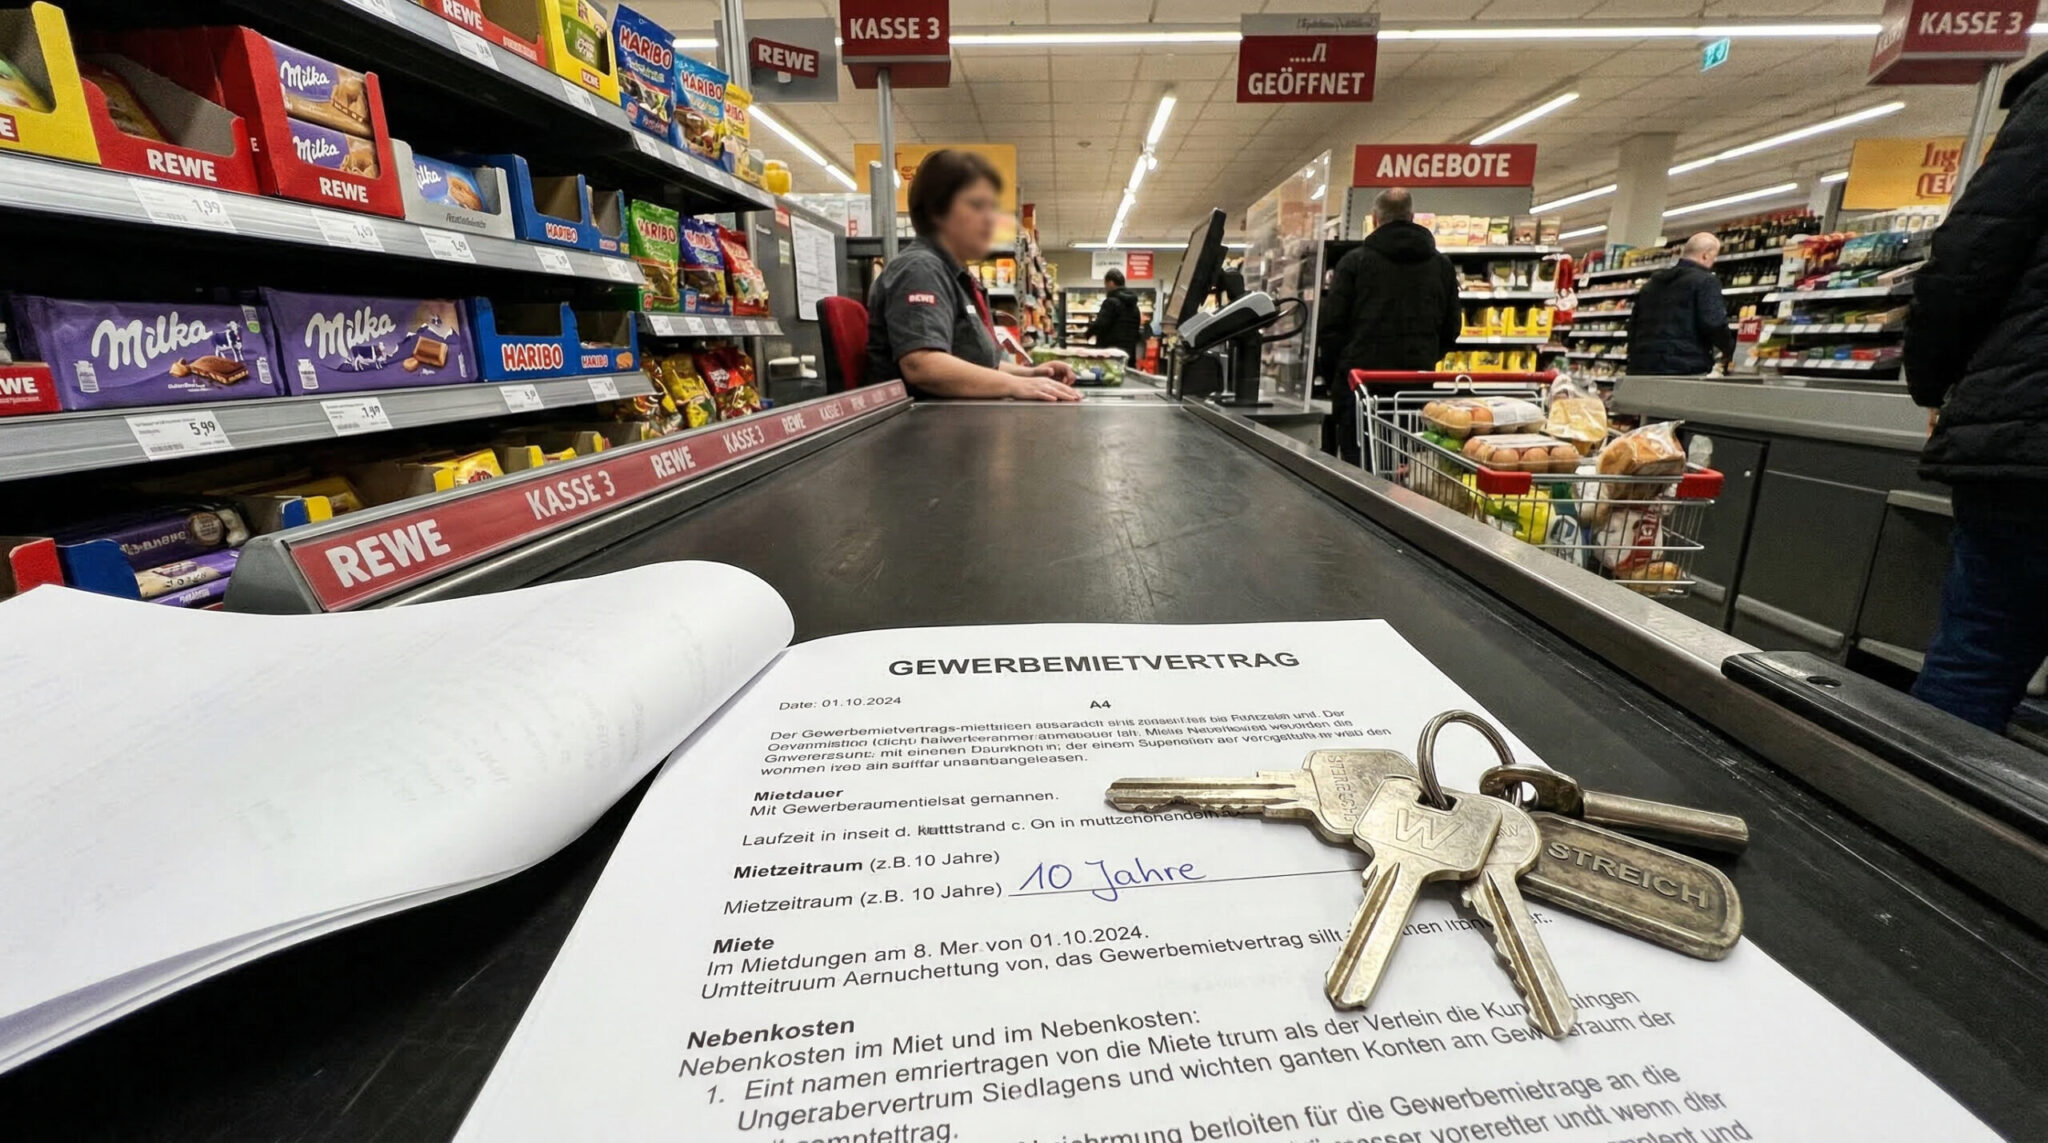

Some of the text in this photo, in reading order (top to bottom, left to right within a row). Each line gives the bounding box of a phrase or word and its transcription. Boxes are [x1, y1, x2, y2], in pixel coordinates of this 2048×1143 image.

[441, 0, 483, 31] REWE
[850, 17, 940, 39] KASSE 3
[1919, 11, 2023, 36] KASSE 3
[620, 25, 673, 70] HARIBO
[758, 44, 815, 72] REWE
[280, 60, 330, 91] Milka
[681, 71, 723, 100] HARIBO
[1248, 67, 1365, 95] GEÖFFNET
[292, 135, 340, 164] Milka
[146, 149, 217, 182] REWE
[1376, 153, 1512, 178] ANGEBOTE
[319, 176, 369, 203] REWE
[91, 311, 213, 371] Milka
[305, 306, 396, 359] Milka
[502, 343, 563, 371] HARIBO
[325, 518, 451, 588] REWE
[525, 474, 597, 521] KASSE
[598, 470, 617, 497] 3
[650, 446, 696, 479] REWE
[722, 428, 756, 455] KASSE
[755, 425, 765, 443] 3
[888, 652, 1300, 676] GEWERBEMIETVERTRAG
[779, 696, 902, 711] Date: 01.10.2024
[1089, 700, 1112, 709] A4
[770, 731, 798, 740] Der
[880, 748, 903, 758] mit
[1065, 740, 1088, 750] der
[753, 788, 844, 802] Mietdauer
[750, 804, 776, 817] Mit
[742, 830, 815, 846] Laufzeit
[821, 830, 836, 842] in
[843, 827, 889, 841] inseit
[895, 826, 911, 837] d.
[1011, 821, 1025, 831] c.
[1061, 817, 1075, 828] in
[733, 859, 863, 879] Mietzeitraum
[914, 854, 936, 867] 10
[941, 850, 1000, 867] Jahre)
[1547, 841, 1711, 909] STREICH
[1019, 857, 1207, 902] 10 Jahre
[723, 882, 1002, 915] Mietzeitraum (z.B. 10 Jahre)
[707, 925, 1149, 976] Im Mietdungen am 8. Mer von 01.10.2024.
[712, 936, 775, 954] Miete
[1006, 955, 1049, 972] von,
[1055, 950, 1093, 968] das
[1099, 933, 1304, 964] Gewerbemietvertrag
[678, 1008, 1200, 1078] Nebenkosten im Miet und im Nebenkosten:
[686, 1020, 855, 1050] Nebenkosten
[706, 1085, 726, 1105] 1.
[744, 1077, 794, 1101] Eint
[801, 1070, 887, 1095] namen
[1056, 1048, 1099, 1066] von
[1106, 1038, 1141, 1058] die
[1148, 1032, 1211, 1055] Miete
[1286, 1021, 1318, 1041] als
[1324, 1016, 1360, 1036] der
[1362, 1009, 1442, 1032] Verlein
[1446, 1003, 1481, 1024] die
[737, 1087, 973, 1131] Ungerabervertrum
[982, 1072, 1121, 1103] Siedlagens
[1129, 1062, 1174, 1086] und
[1180, 1053, 1272, 1079] wichten
[1279, 1043, 1359, 1074] ganten
[1363, 1032, 1446, 1059] Konten
[1450, 1032, 1488, 1050] am
[1638, 1008, 1677, 1028] der
[1304, 1105, 1338, 1128] für
[1346, 1100, 1385, 1122] die
[1390, 1075, 1603, 1116] Gewerbemietrage
[1607, 1072, 1640, 1091] an
[1642, 1064, 1681, 1085] die
[1554, 1103, 1612, 1130] undt
[1611, 1098, 1681, 1122] wenn
[1701, 1119, 1754, 1143] und
